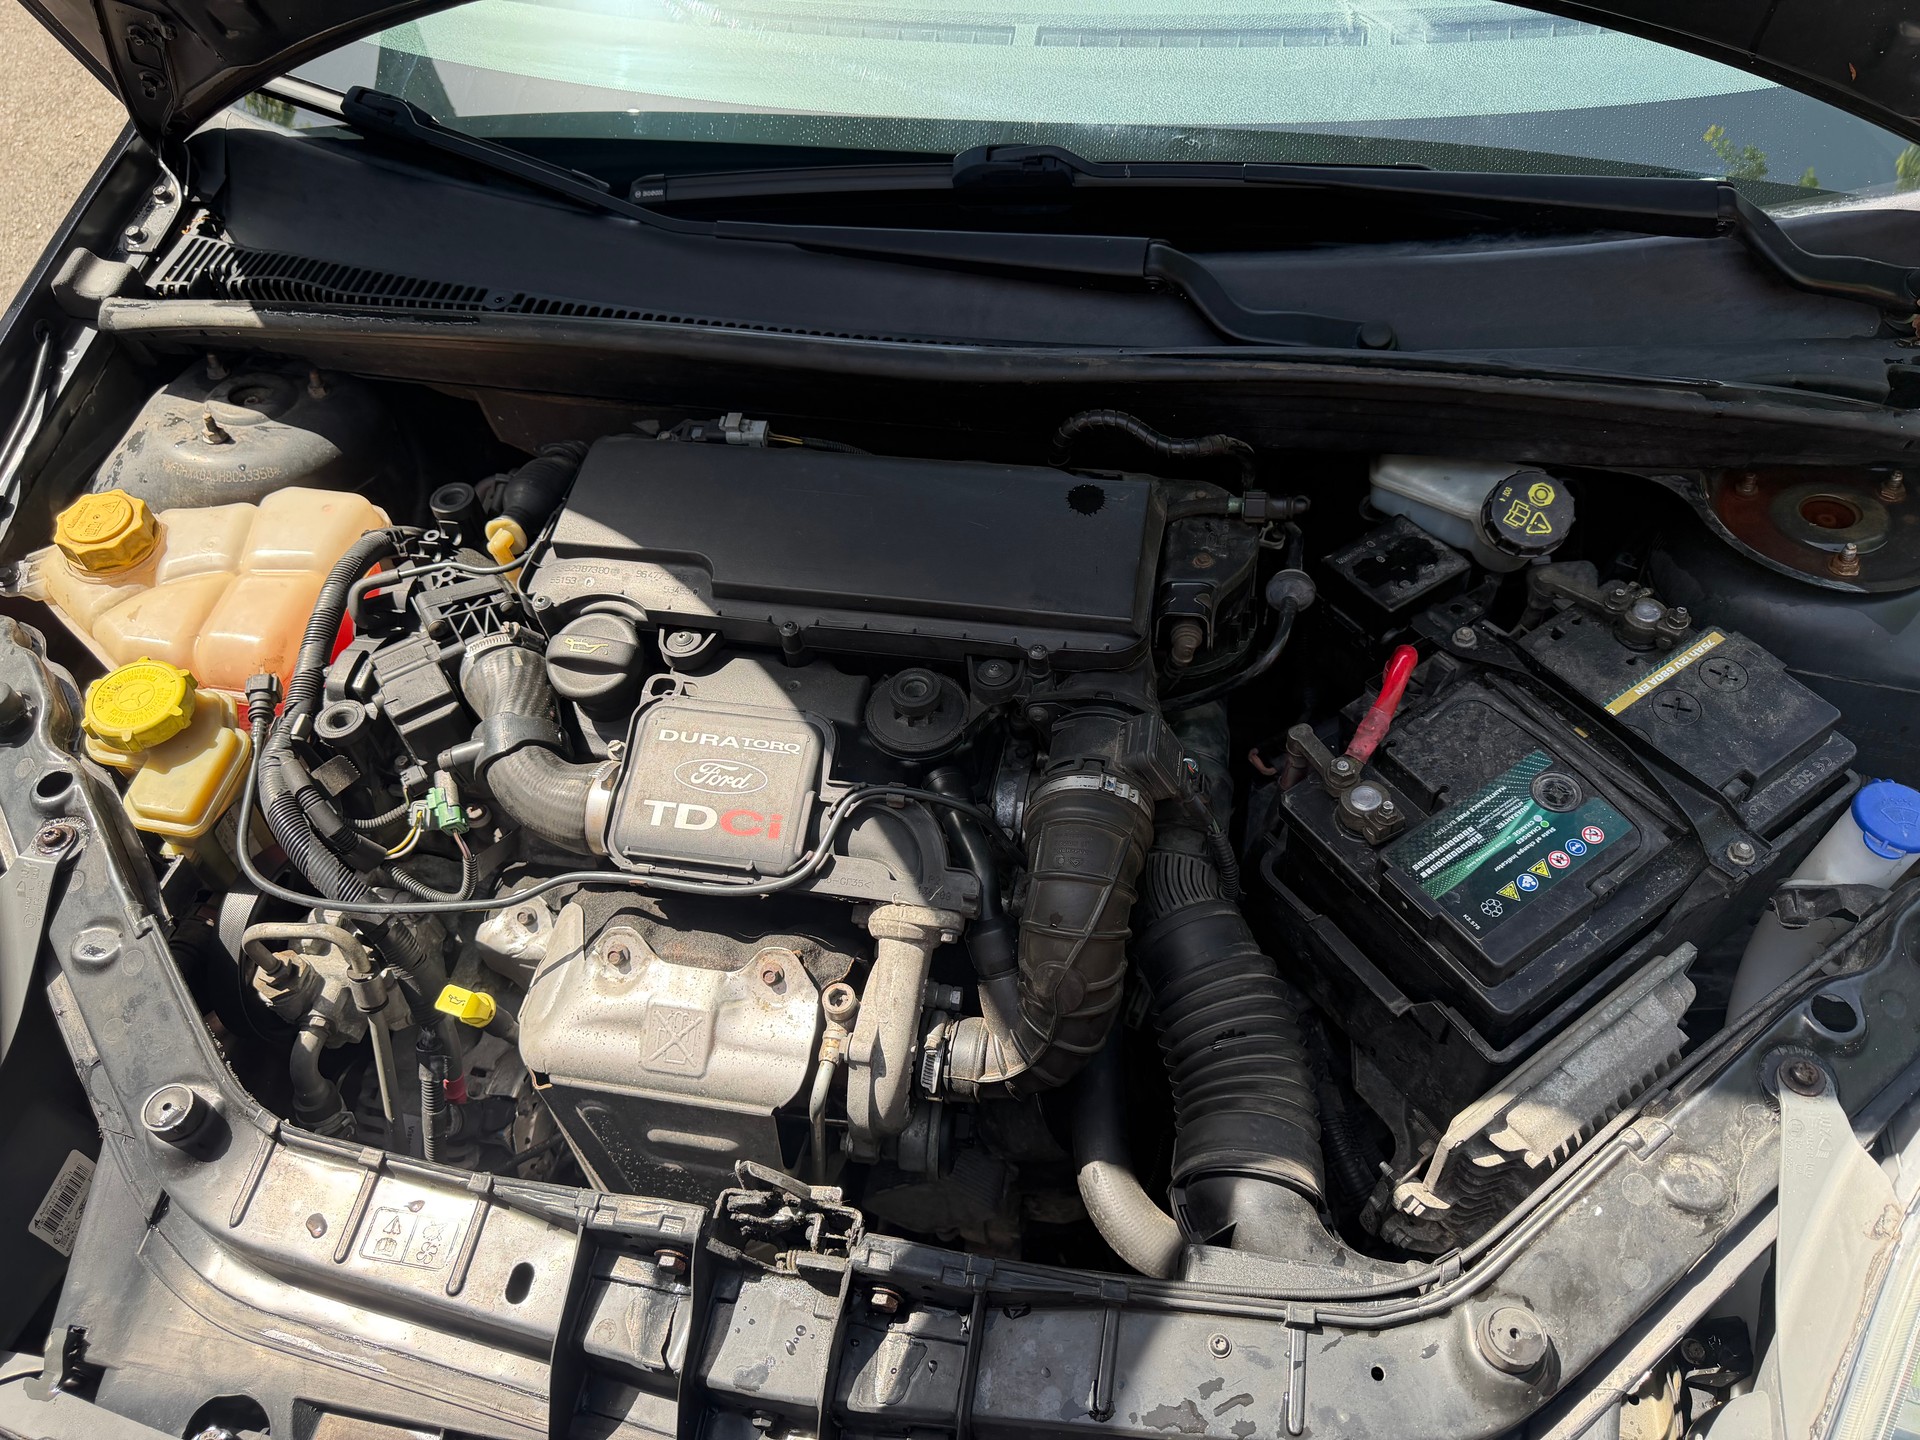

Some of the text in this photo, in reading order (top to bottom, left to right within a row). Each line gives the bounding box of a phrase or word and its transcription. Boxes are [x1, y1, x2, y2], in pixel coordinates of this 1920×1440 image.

[1634, 639, 1716, 696] 75Ah 12V 680A EN
[658, 729, 801, 755] DURATORQ
[690, 762, 754, 790] Ford
[643, 799, 784, 840] TDCi
[1455, 810, 1470, 822] FREE
[1433, 819, 1456, 837] BATTERY
[1515, 825, 1541, 845] CHARGED
[1541, 826, 1555, 839] State
